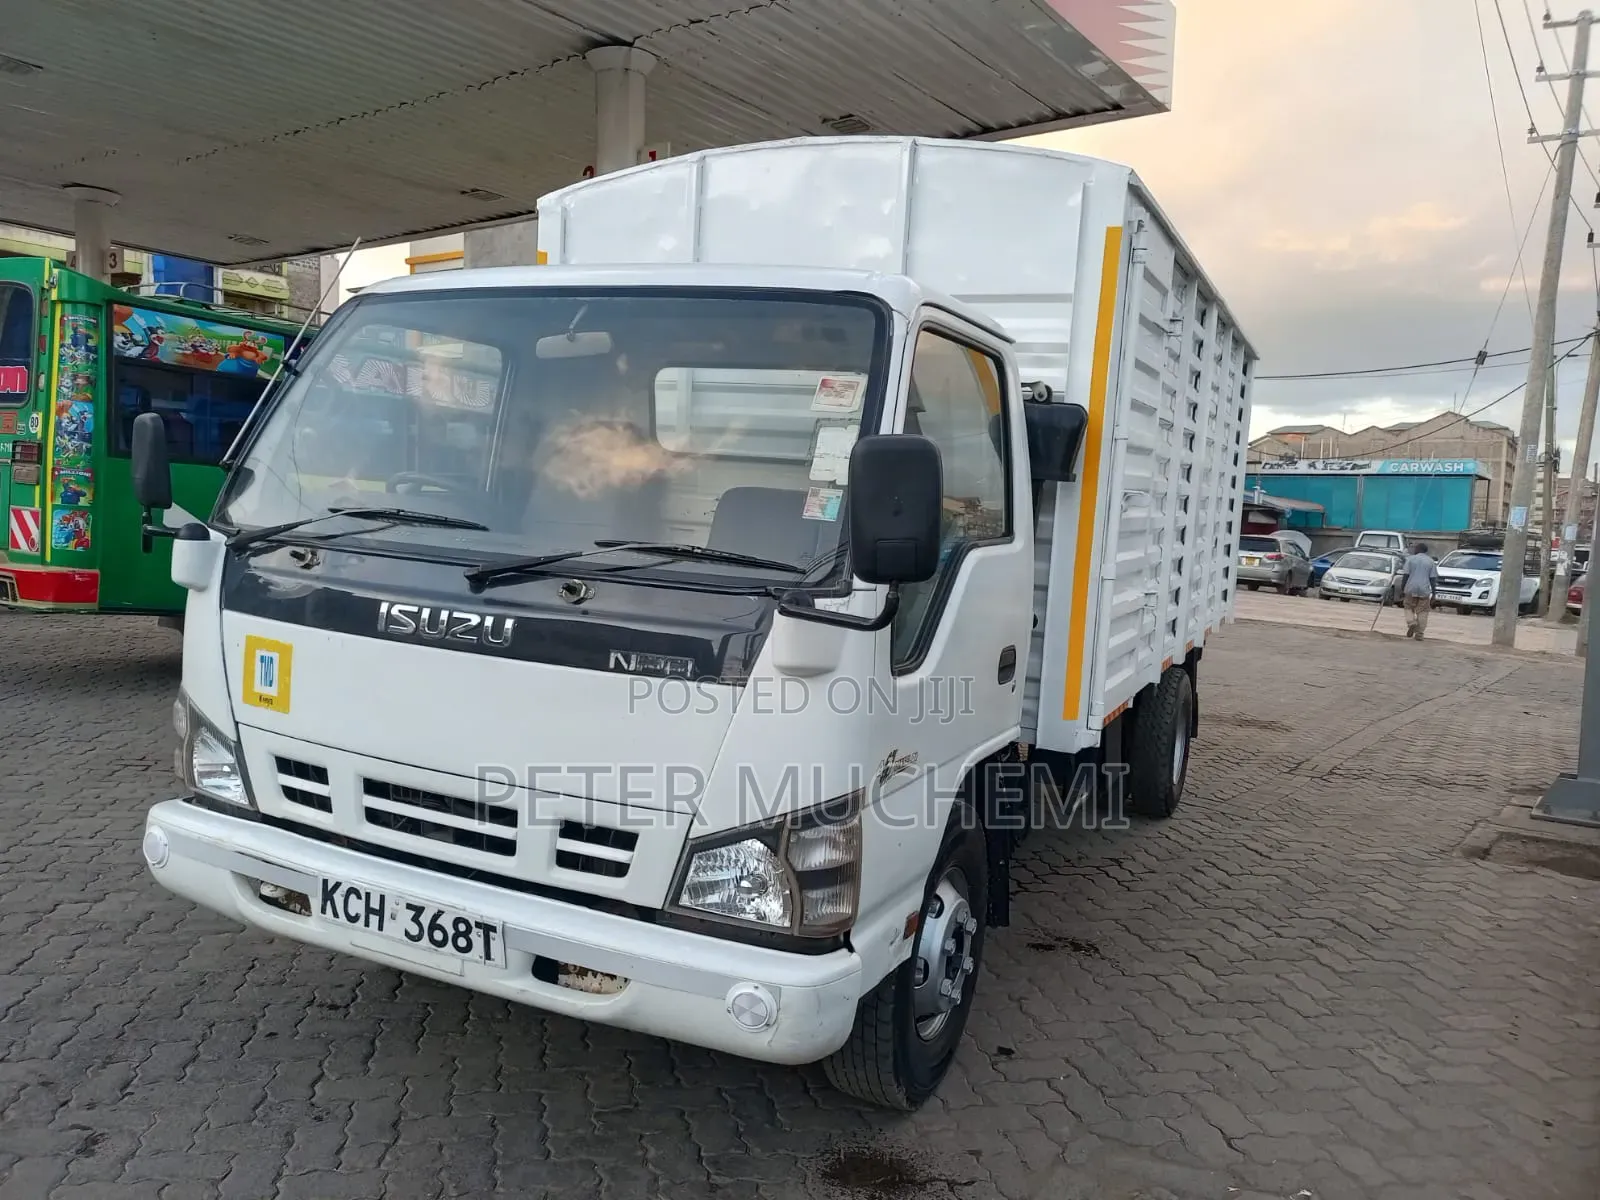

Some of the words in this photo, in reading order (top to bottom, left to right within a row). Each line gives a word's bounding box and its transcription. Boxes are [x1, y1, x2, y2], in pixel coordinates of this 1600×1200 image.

[108, 252, 118, 269] 3
[1390, 461, 1465, 473] CARWASH
[376, 602, 516, 648] ISUZU
[320, 878, 386, 932] KCH
[404, 902, 497, 961] 368T
